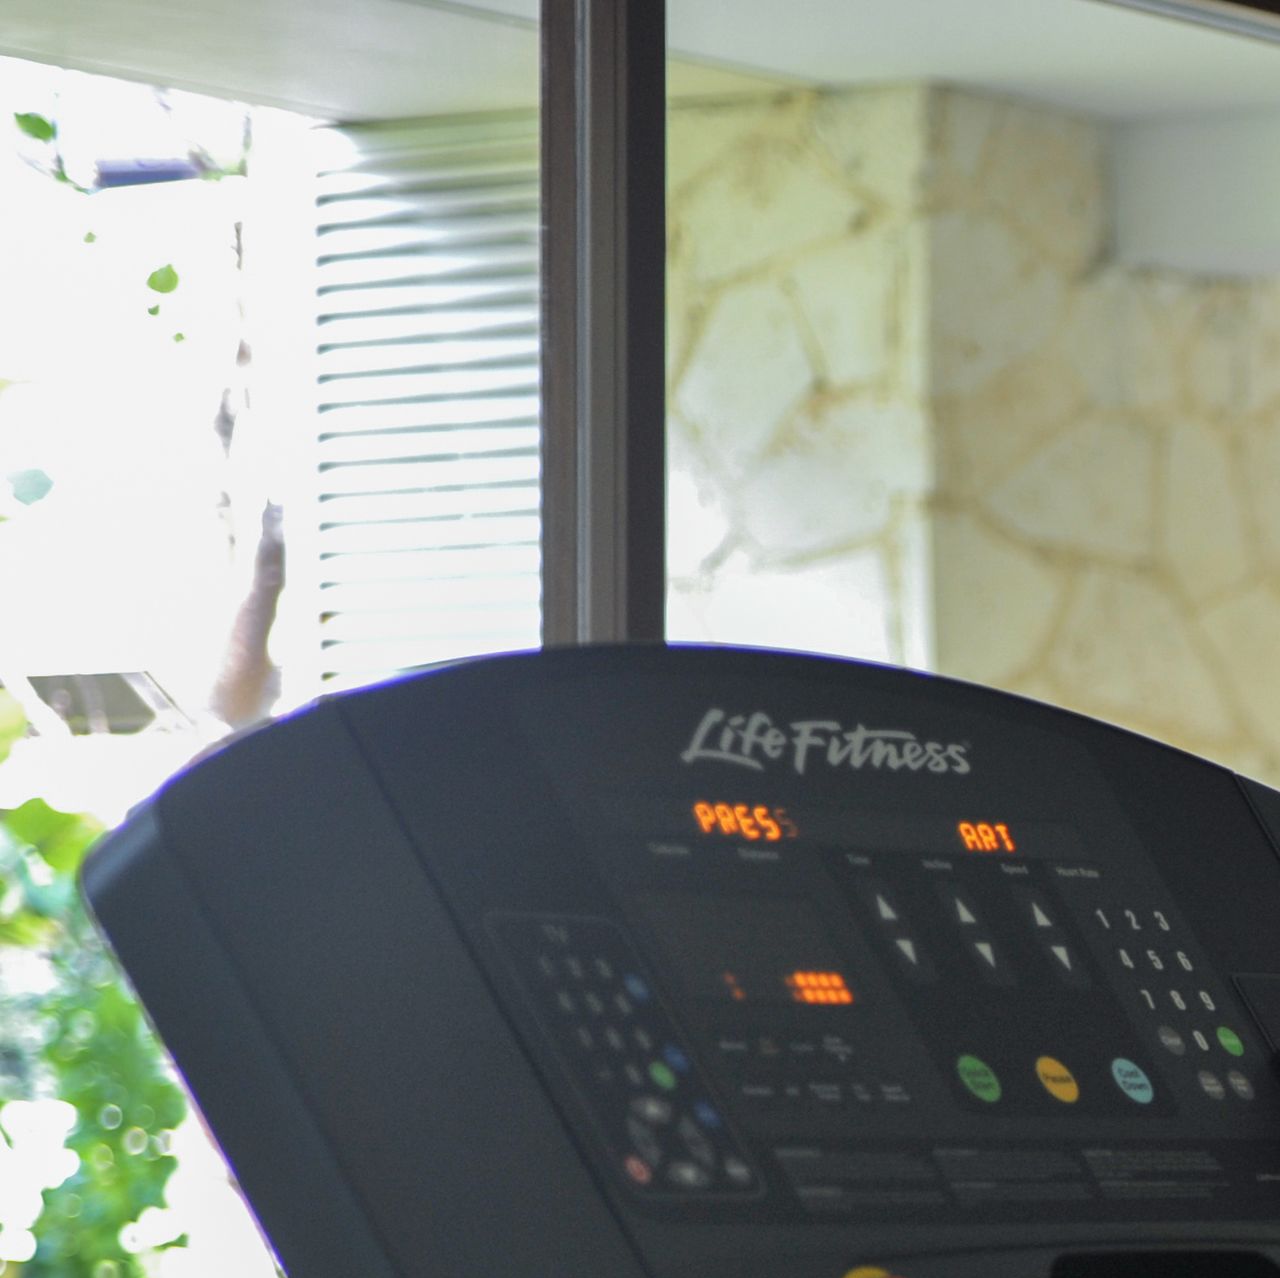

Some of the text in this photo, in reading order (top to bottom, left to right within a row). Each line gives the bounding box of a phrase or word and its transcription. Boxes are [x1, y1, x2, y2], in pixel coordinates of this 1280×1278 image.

[1096, 908, 1171, 932] 1 2 3
[1119, 948, 1194, 972] 4 5 6
[1140, 988, 1216, 1012] 7 8 9
[1192, 1029, 1210, 1051] 0
